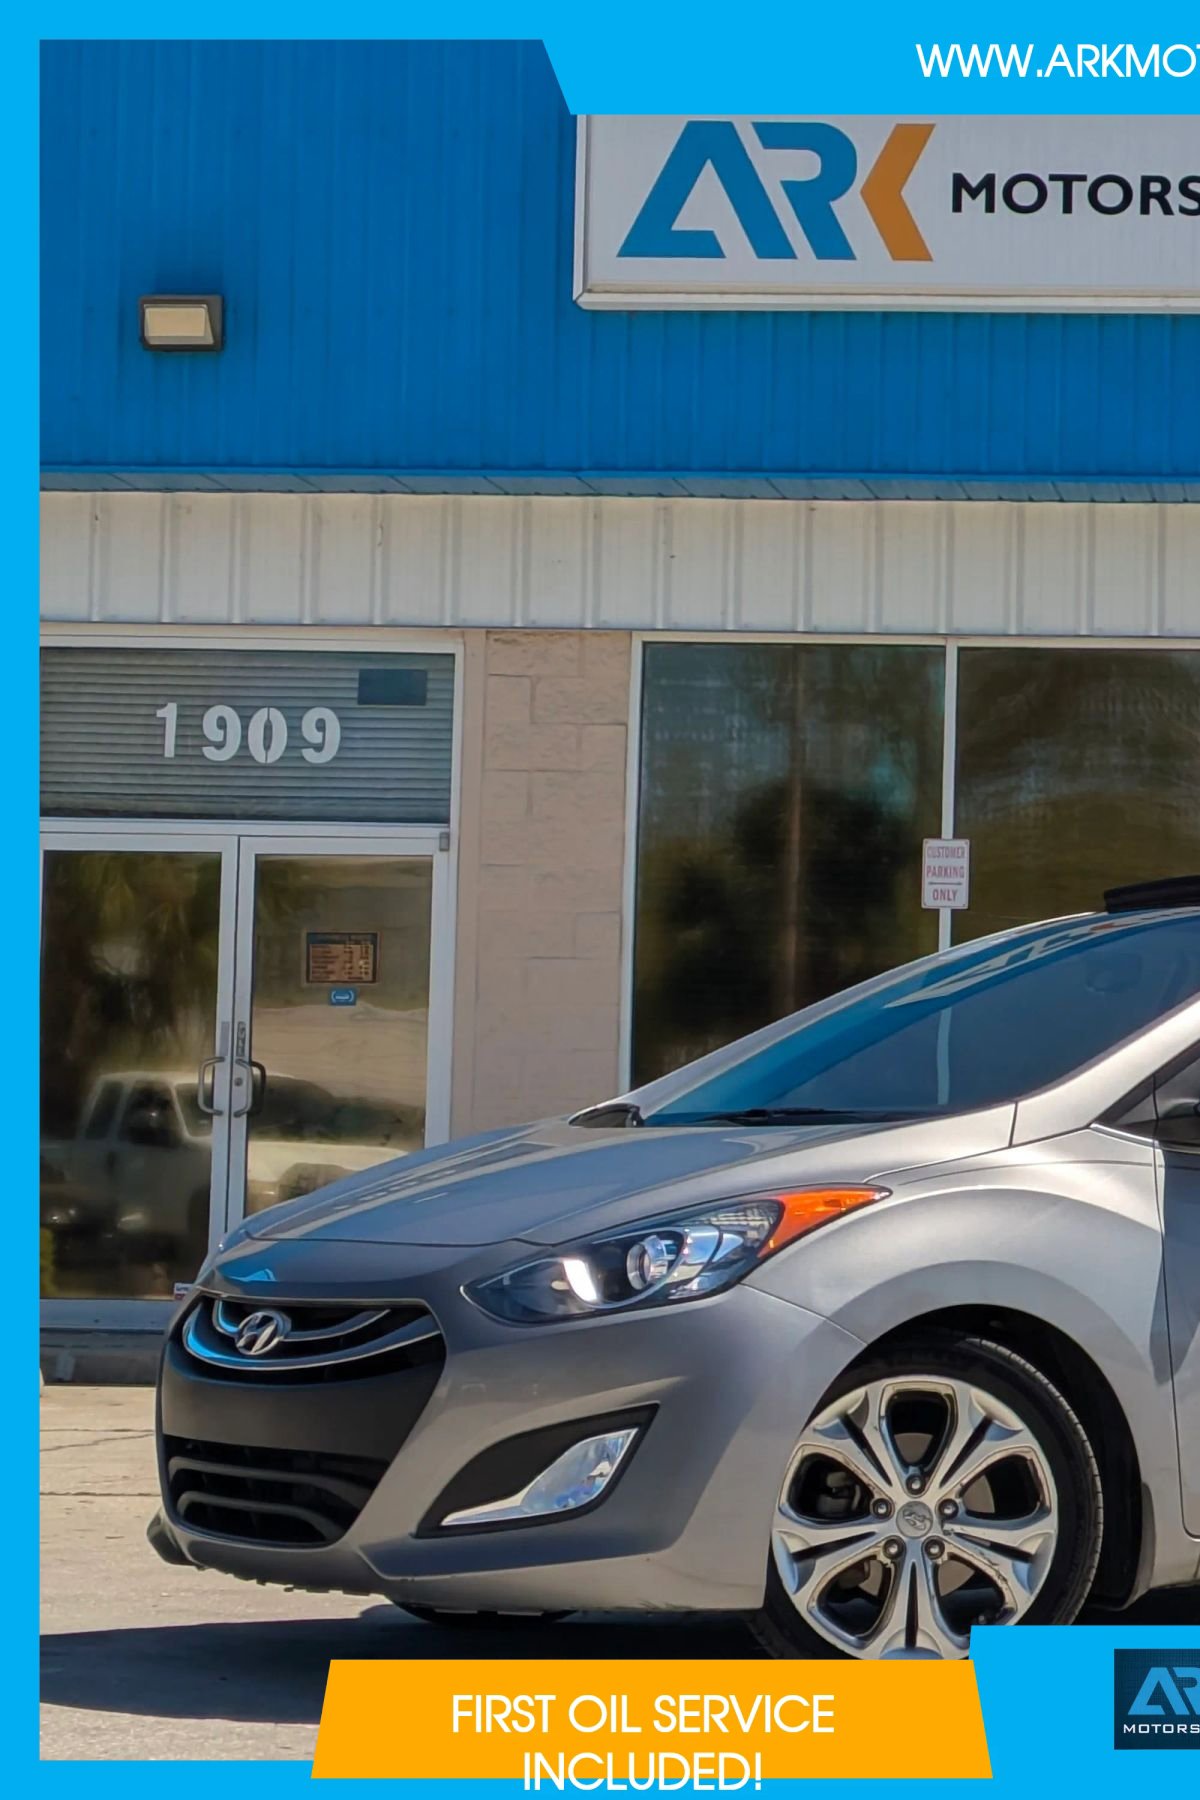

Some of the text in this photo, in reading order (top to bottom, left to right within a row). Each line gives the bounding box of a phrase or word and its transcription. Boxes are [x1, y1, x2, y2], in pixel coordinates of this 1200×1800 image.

[617, 120, 936, 261] ARK
[156, 702, 341, 764] 1909
[927, 846, 966, 858] CUSTOMER
[926, 865, 965, 878] PARKING
[932, 888, 958, 901] ONLY
